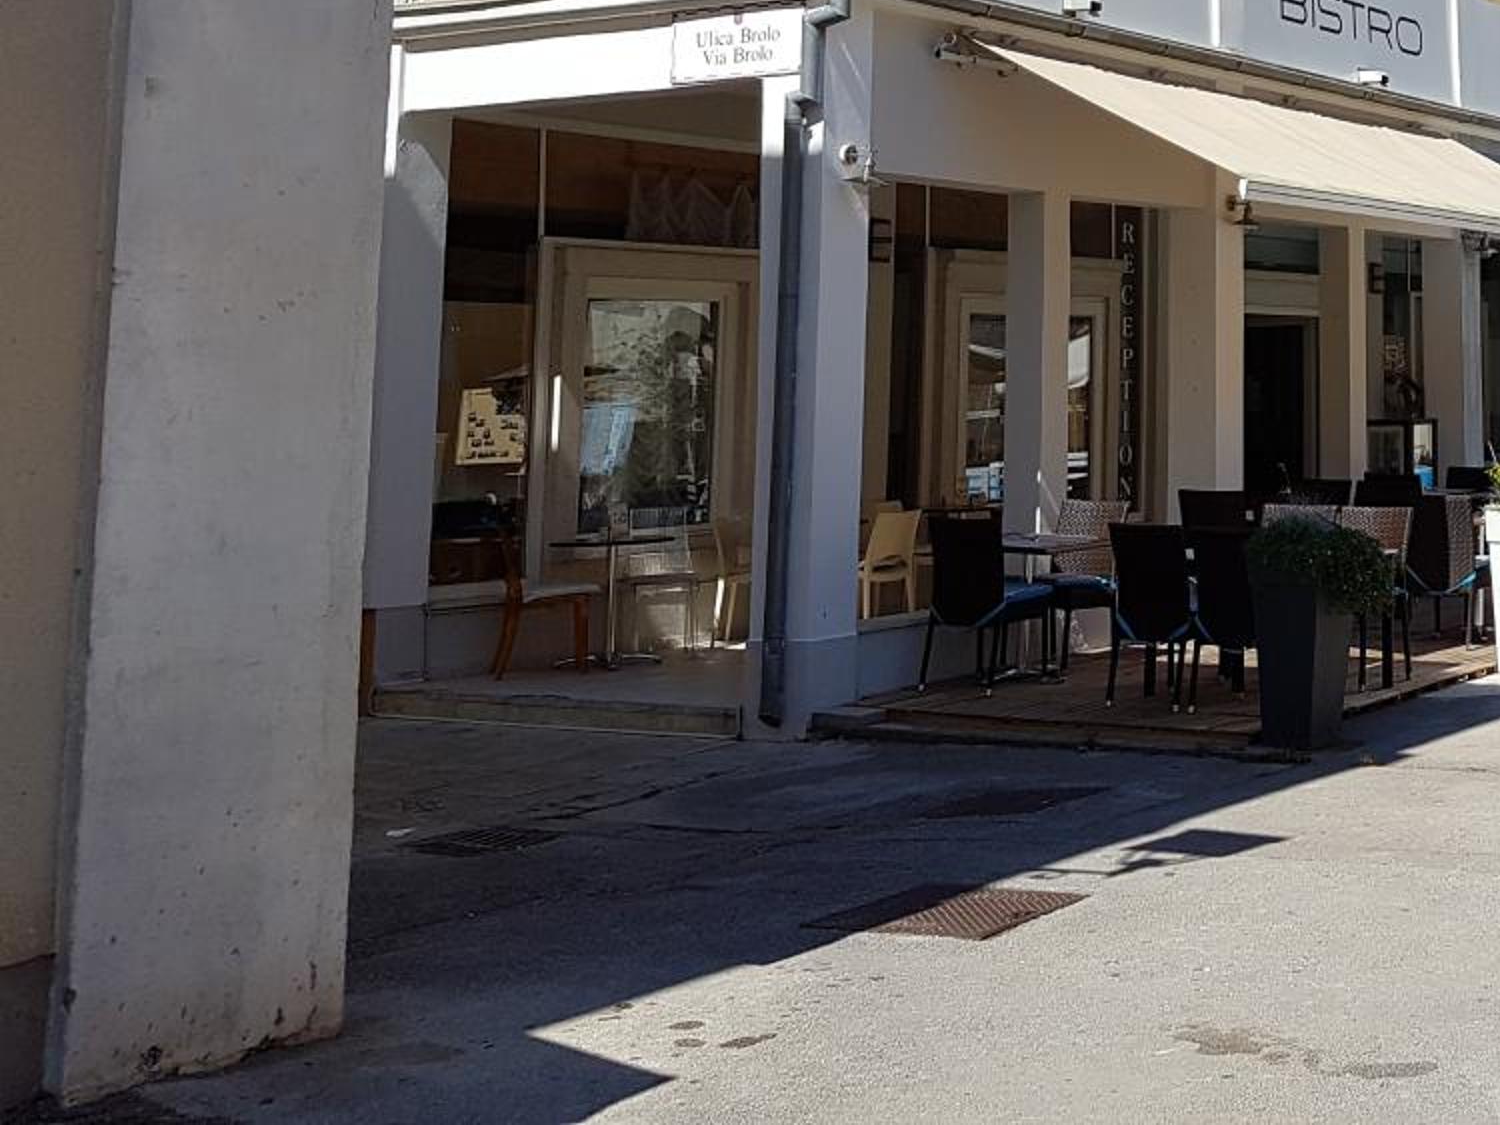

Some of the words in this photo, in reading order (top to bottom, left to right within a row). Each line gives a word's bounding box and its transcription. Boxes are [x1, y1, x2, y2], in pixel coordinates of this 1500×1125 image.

[696, 29, 734, 48] Ulica
[740, 24, 781, 44] Brolo
[703, 48, 727, 66] Via
[733, 45, 773, 64] Brolo
[1118, 221, 1136, 498] RECEPTION
